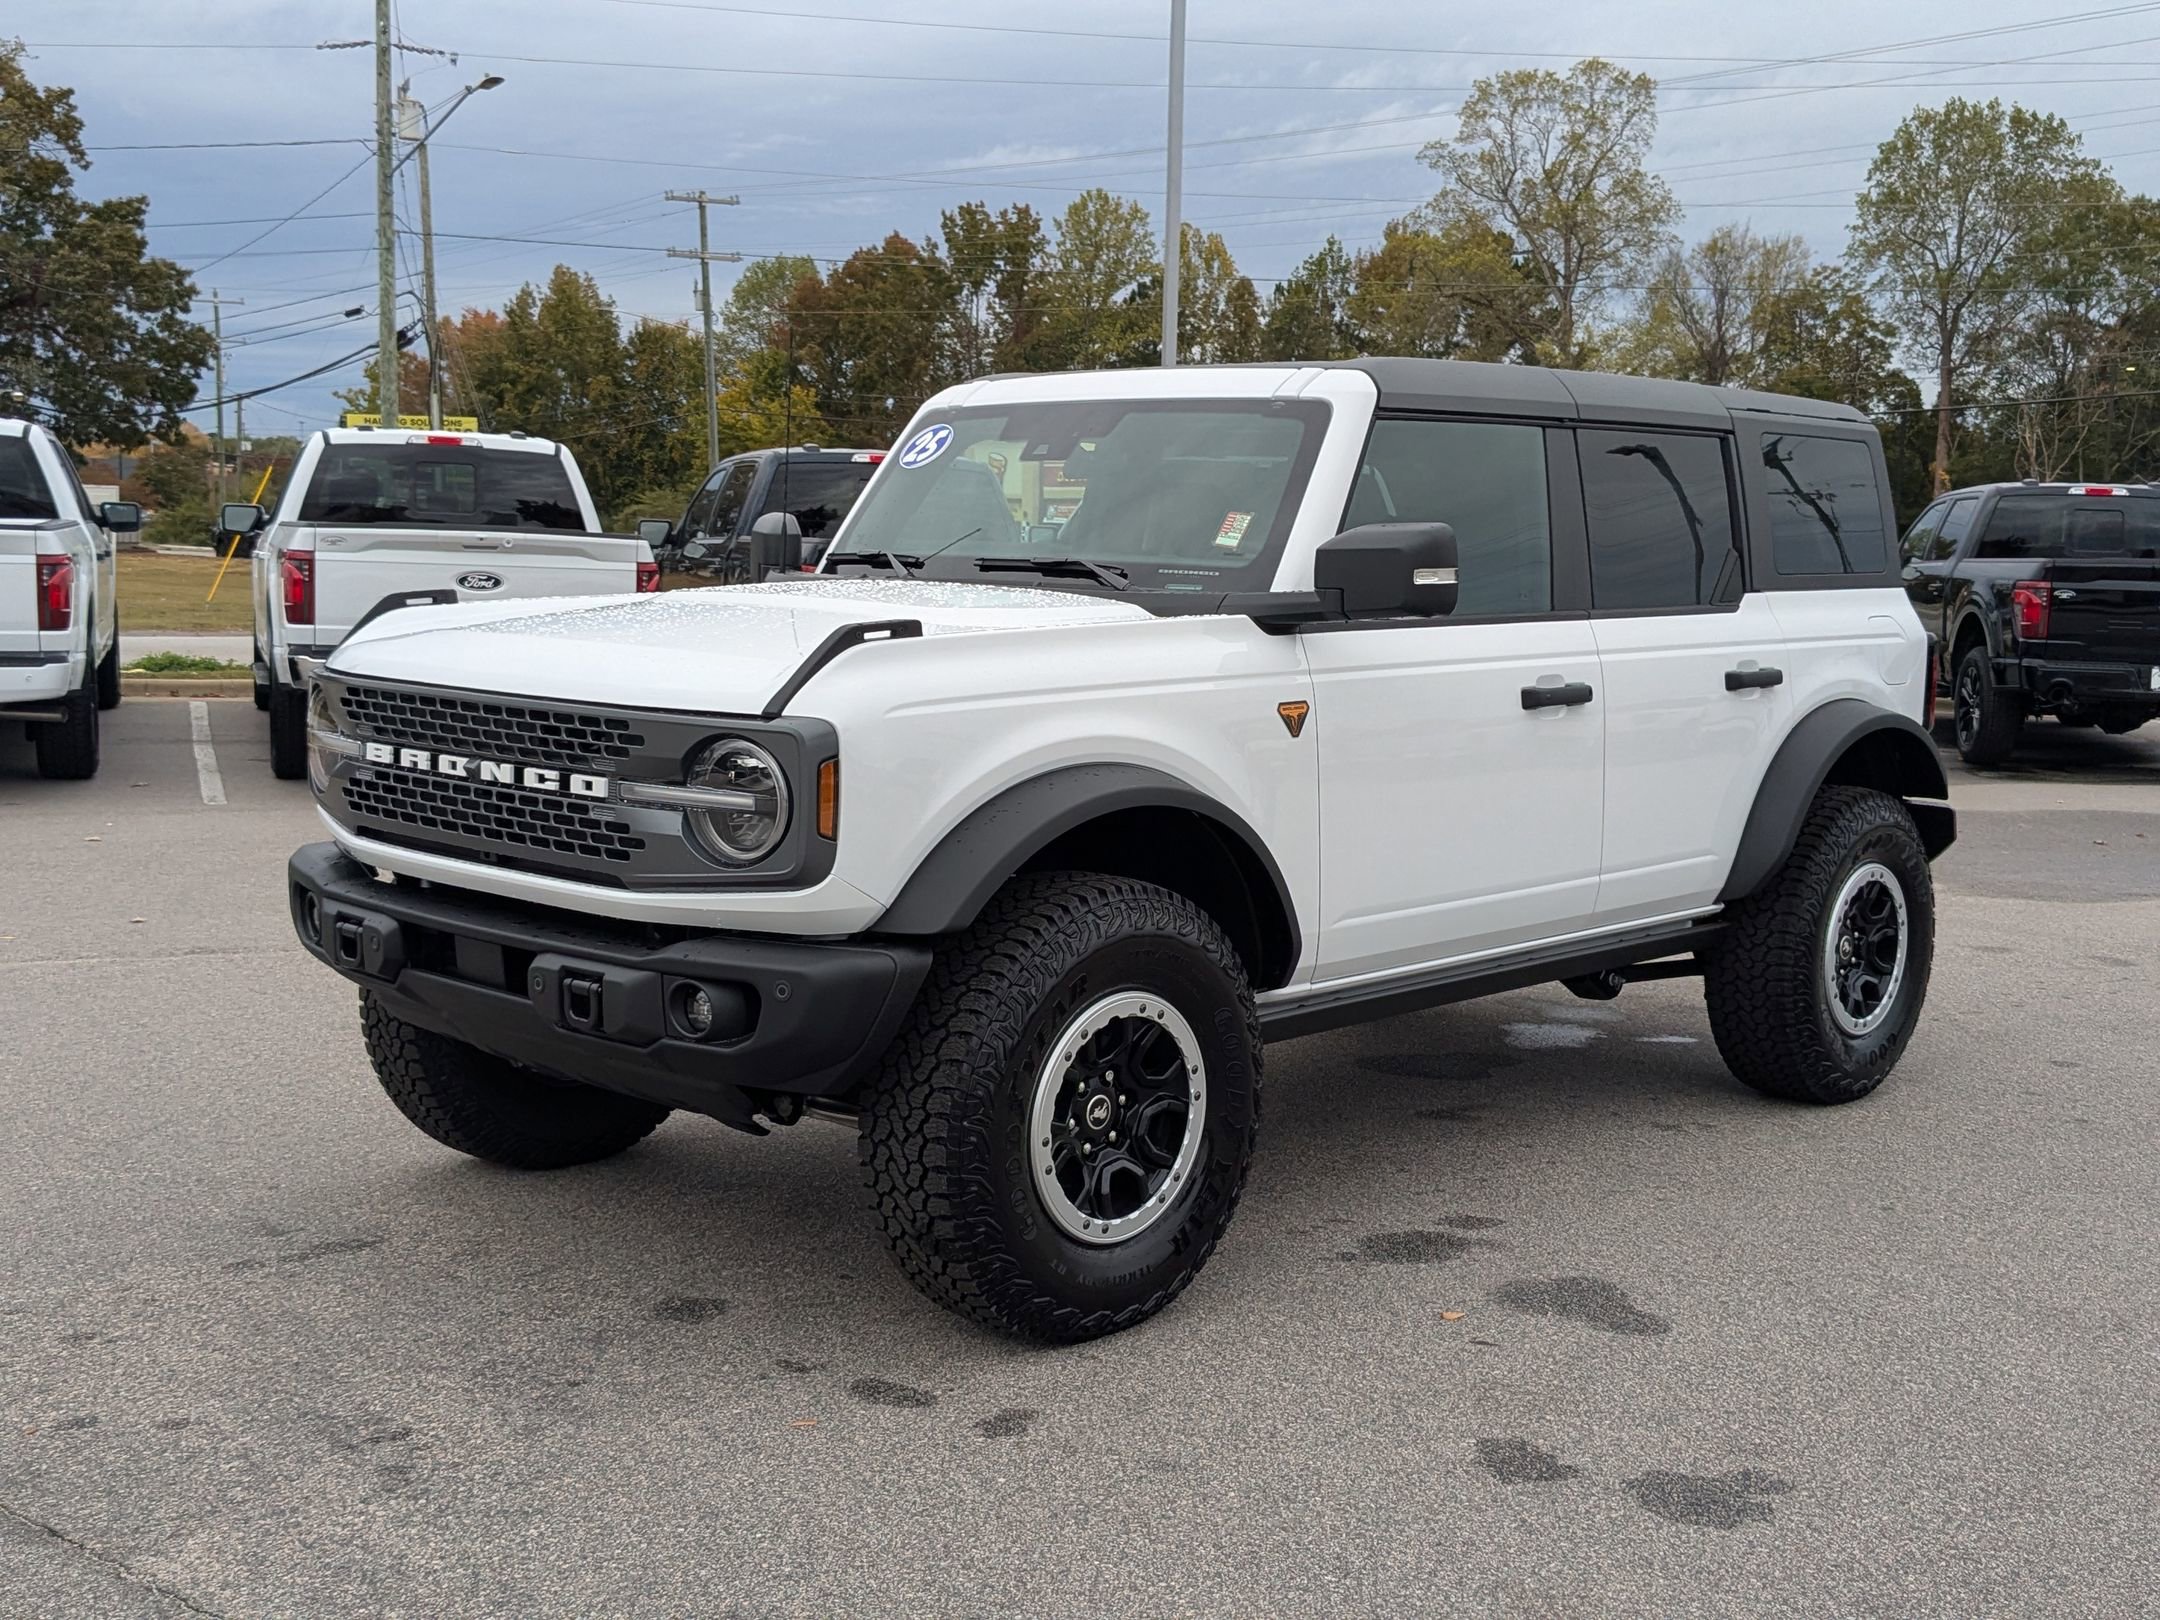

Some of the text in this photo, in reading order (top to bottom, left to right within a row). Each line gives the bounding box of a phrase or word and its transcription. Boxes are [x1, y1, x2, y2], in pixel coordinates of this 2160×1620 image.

[410, 418, 463, 427] SOLONS
[902, 429, 950, 463] 25
[464, 575, 496, 588] Ford
[366, 742, 609, 798] BRONCO
